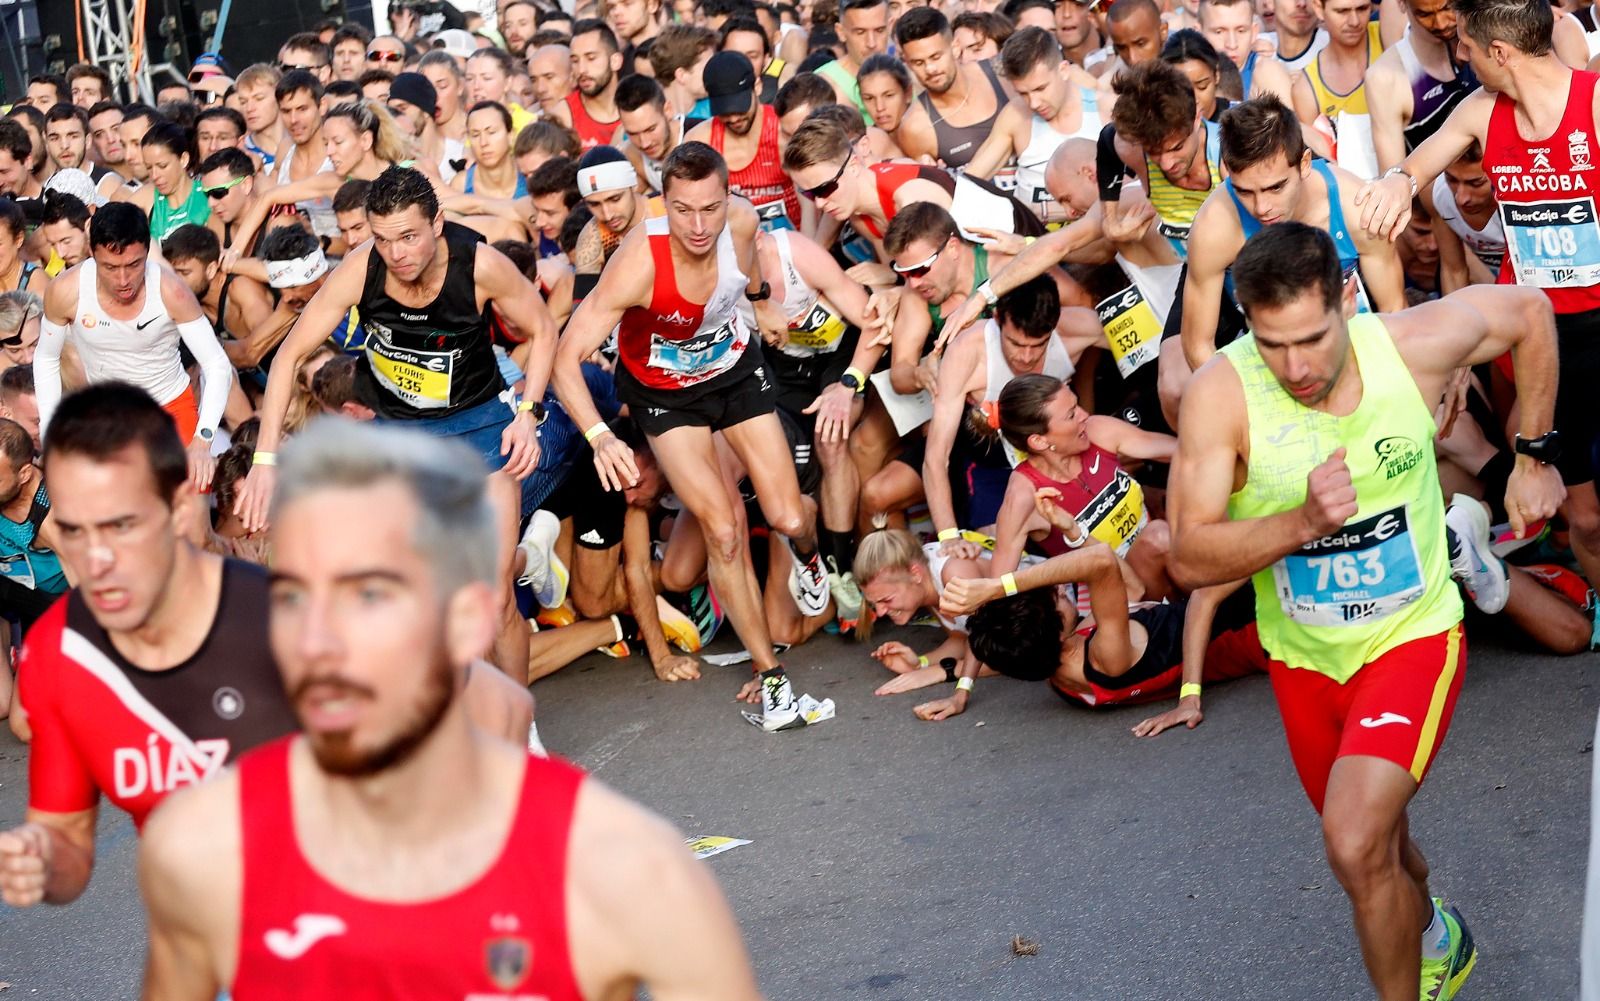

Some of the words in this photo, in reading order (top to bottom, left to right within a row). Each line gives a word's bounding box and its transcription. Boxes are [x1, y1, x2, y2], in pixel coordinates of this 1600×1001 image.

[1492, 165, 1522, 173] LOREDO
[1498, 174, 1587, 192] CARCOBA
[1511, 209, 1559, 222] iberCaja
[1526, 226, 1577, 257] 708
[1551, 268, 1574, 284] 10K
[1116, 330, 1142, 353] 332
[373, 342, 419, 364] iberCaja
[676, 345, 714, 366] 571
[393, 364, 425, 381] FLORIS
[395, 375, 422, 393] 335
[1386, 448, 1423, 480] ALBACETE
[1109, 502, 1130, 527] FINOT
[1117, 513, 1138, 539] 220
[1307, 548, 1385, 592] 763
[1341, 601, 1376, 621] 10K
[114, 732, 230, 799] DÍAZ
